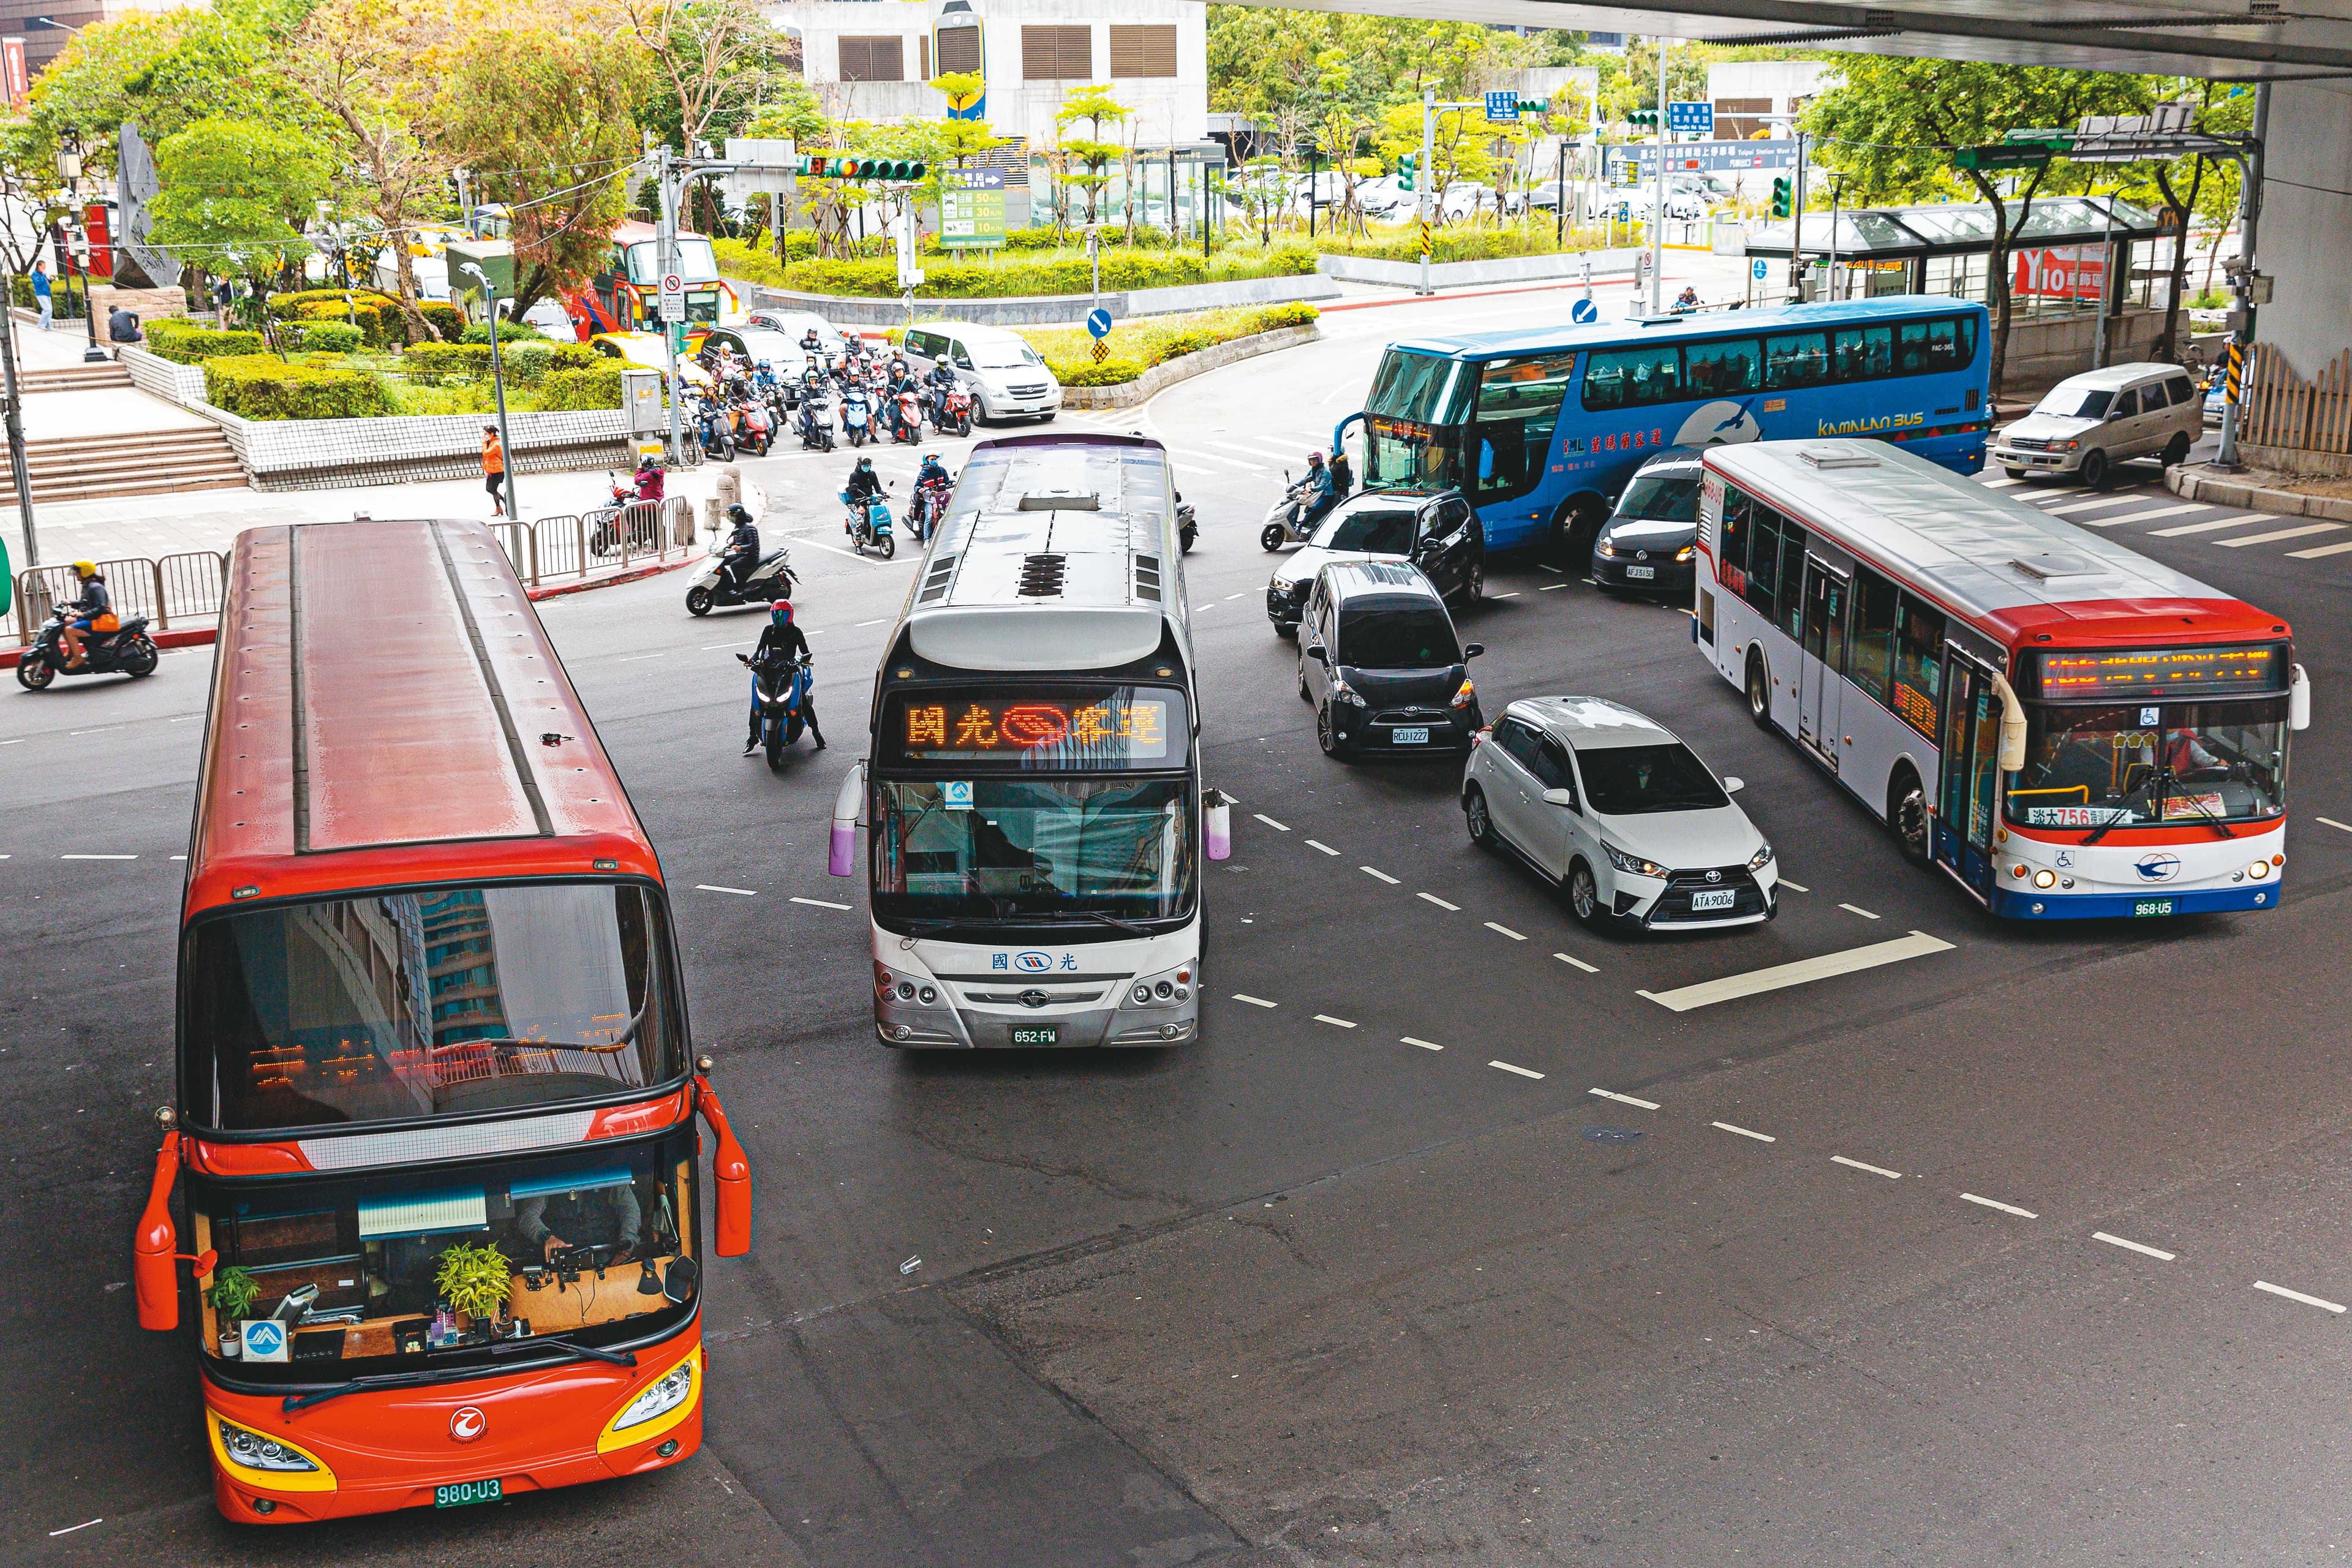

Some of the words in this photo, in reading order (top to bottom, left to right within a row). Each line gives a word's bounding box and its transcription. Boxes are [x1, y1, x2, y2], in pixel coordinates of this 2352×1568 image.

[1640, 145, 1736, 160] 臺北站西側地上停車場
[2023, 251, 2065, 292] Y10
[1893, 411, 1924, 428] BUS
[909, 704, 999, 745] 國光
[2135, 902, 2172, 915] 968-U5
[992, 953, 1008, 970] 國
[1059, 953, 1078, 971] 光
[1014, 1031, 1055, 1042] 652-FW
[447, 1428, 489, 1446] Transportation
[437, 1479, 500, 1504] 980-U3
